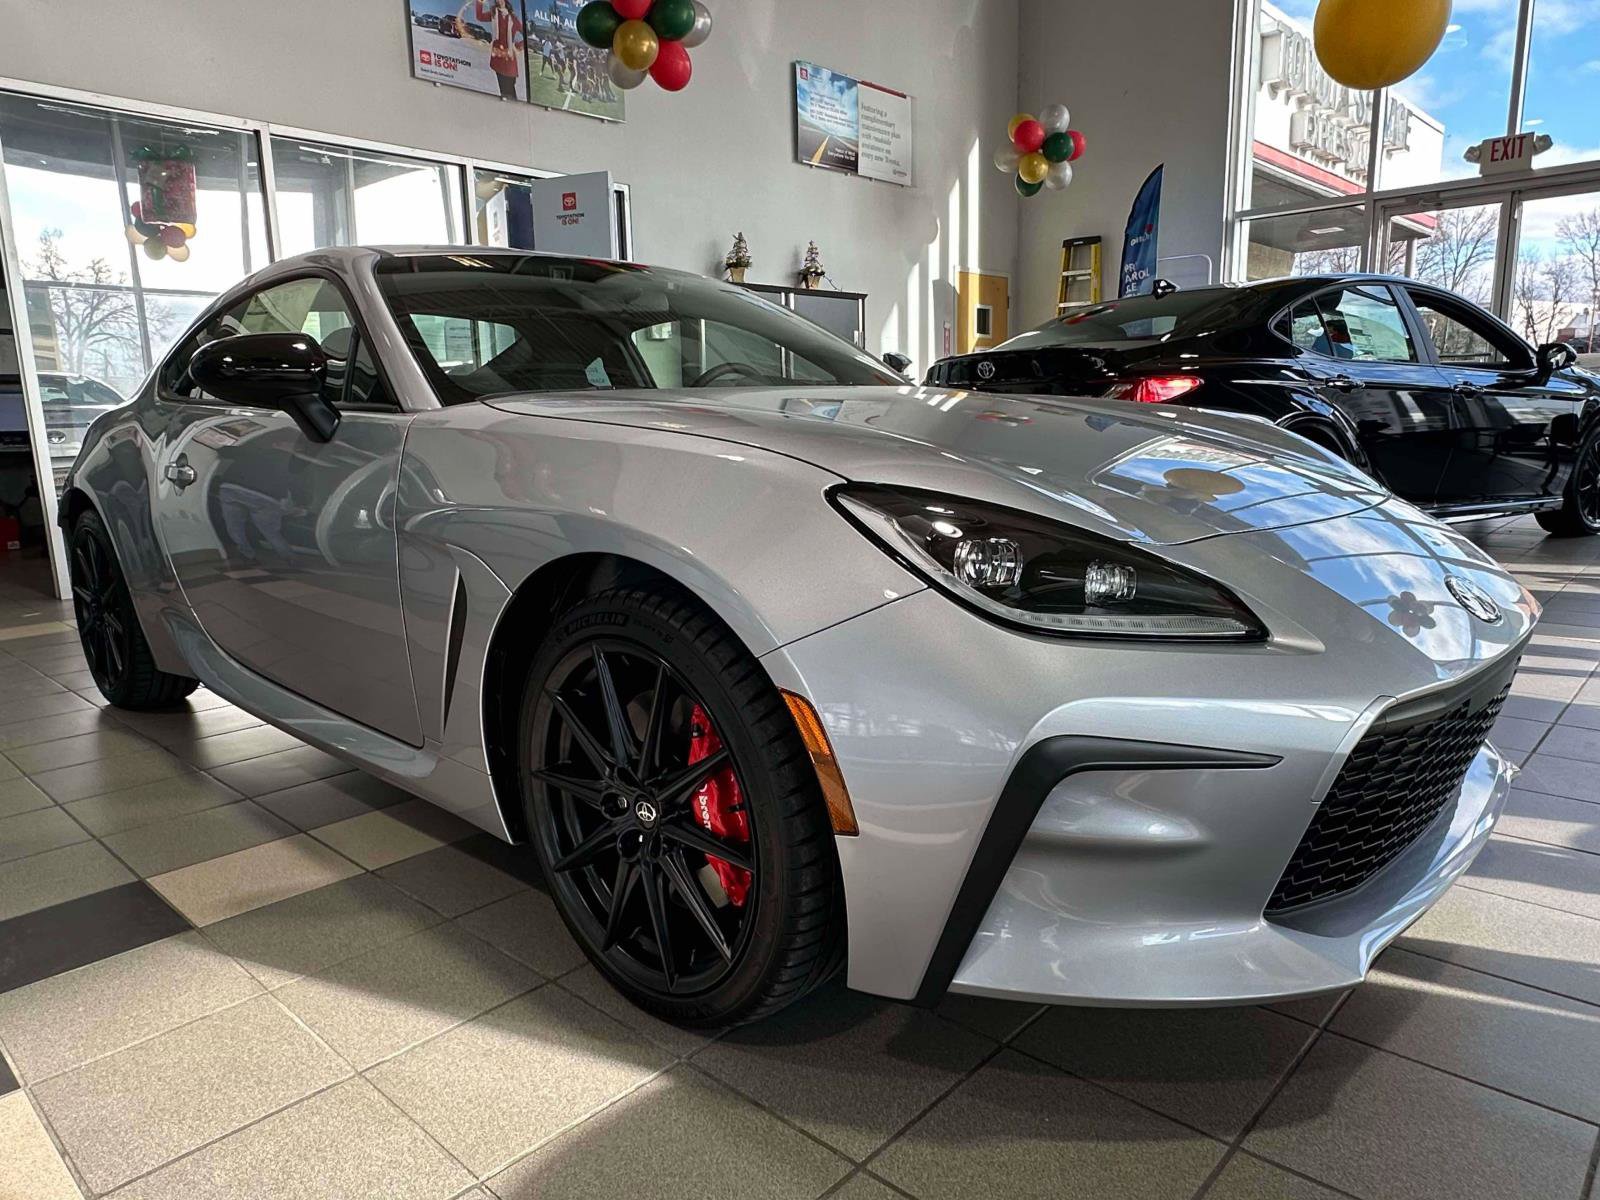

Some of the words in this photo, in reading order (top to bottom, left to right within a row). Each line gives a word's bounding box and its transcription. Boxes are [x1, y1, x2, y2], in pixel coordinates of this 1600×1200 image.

[534, 9, 550, 22] ALL
[433, 53, 472, 67] TOYOTATHON
[434, 59, 442, 68] IS
[442, 61, 459, 72] ON!
[1490, 136, 1526, 162] EXIT
[556, 212, 585, 220] TOYOTATHON
